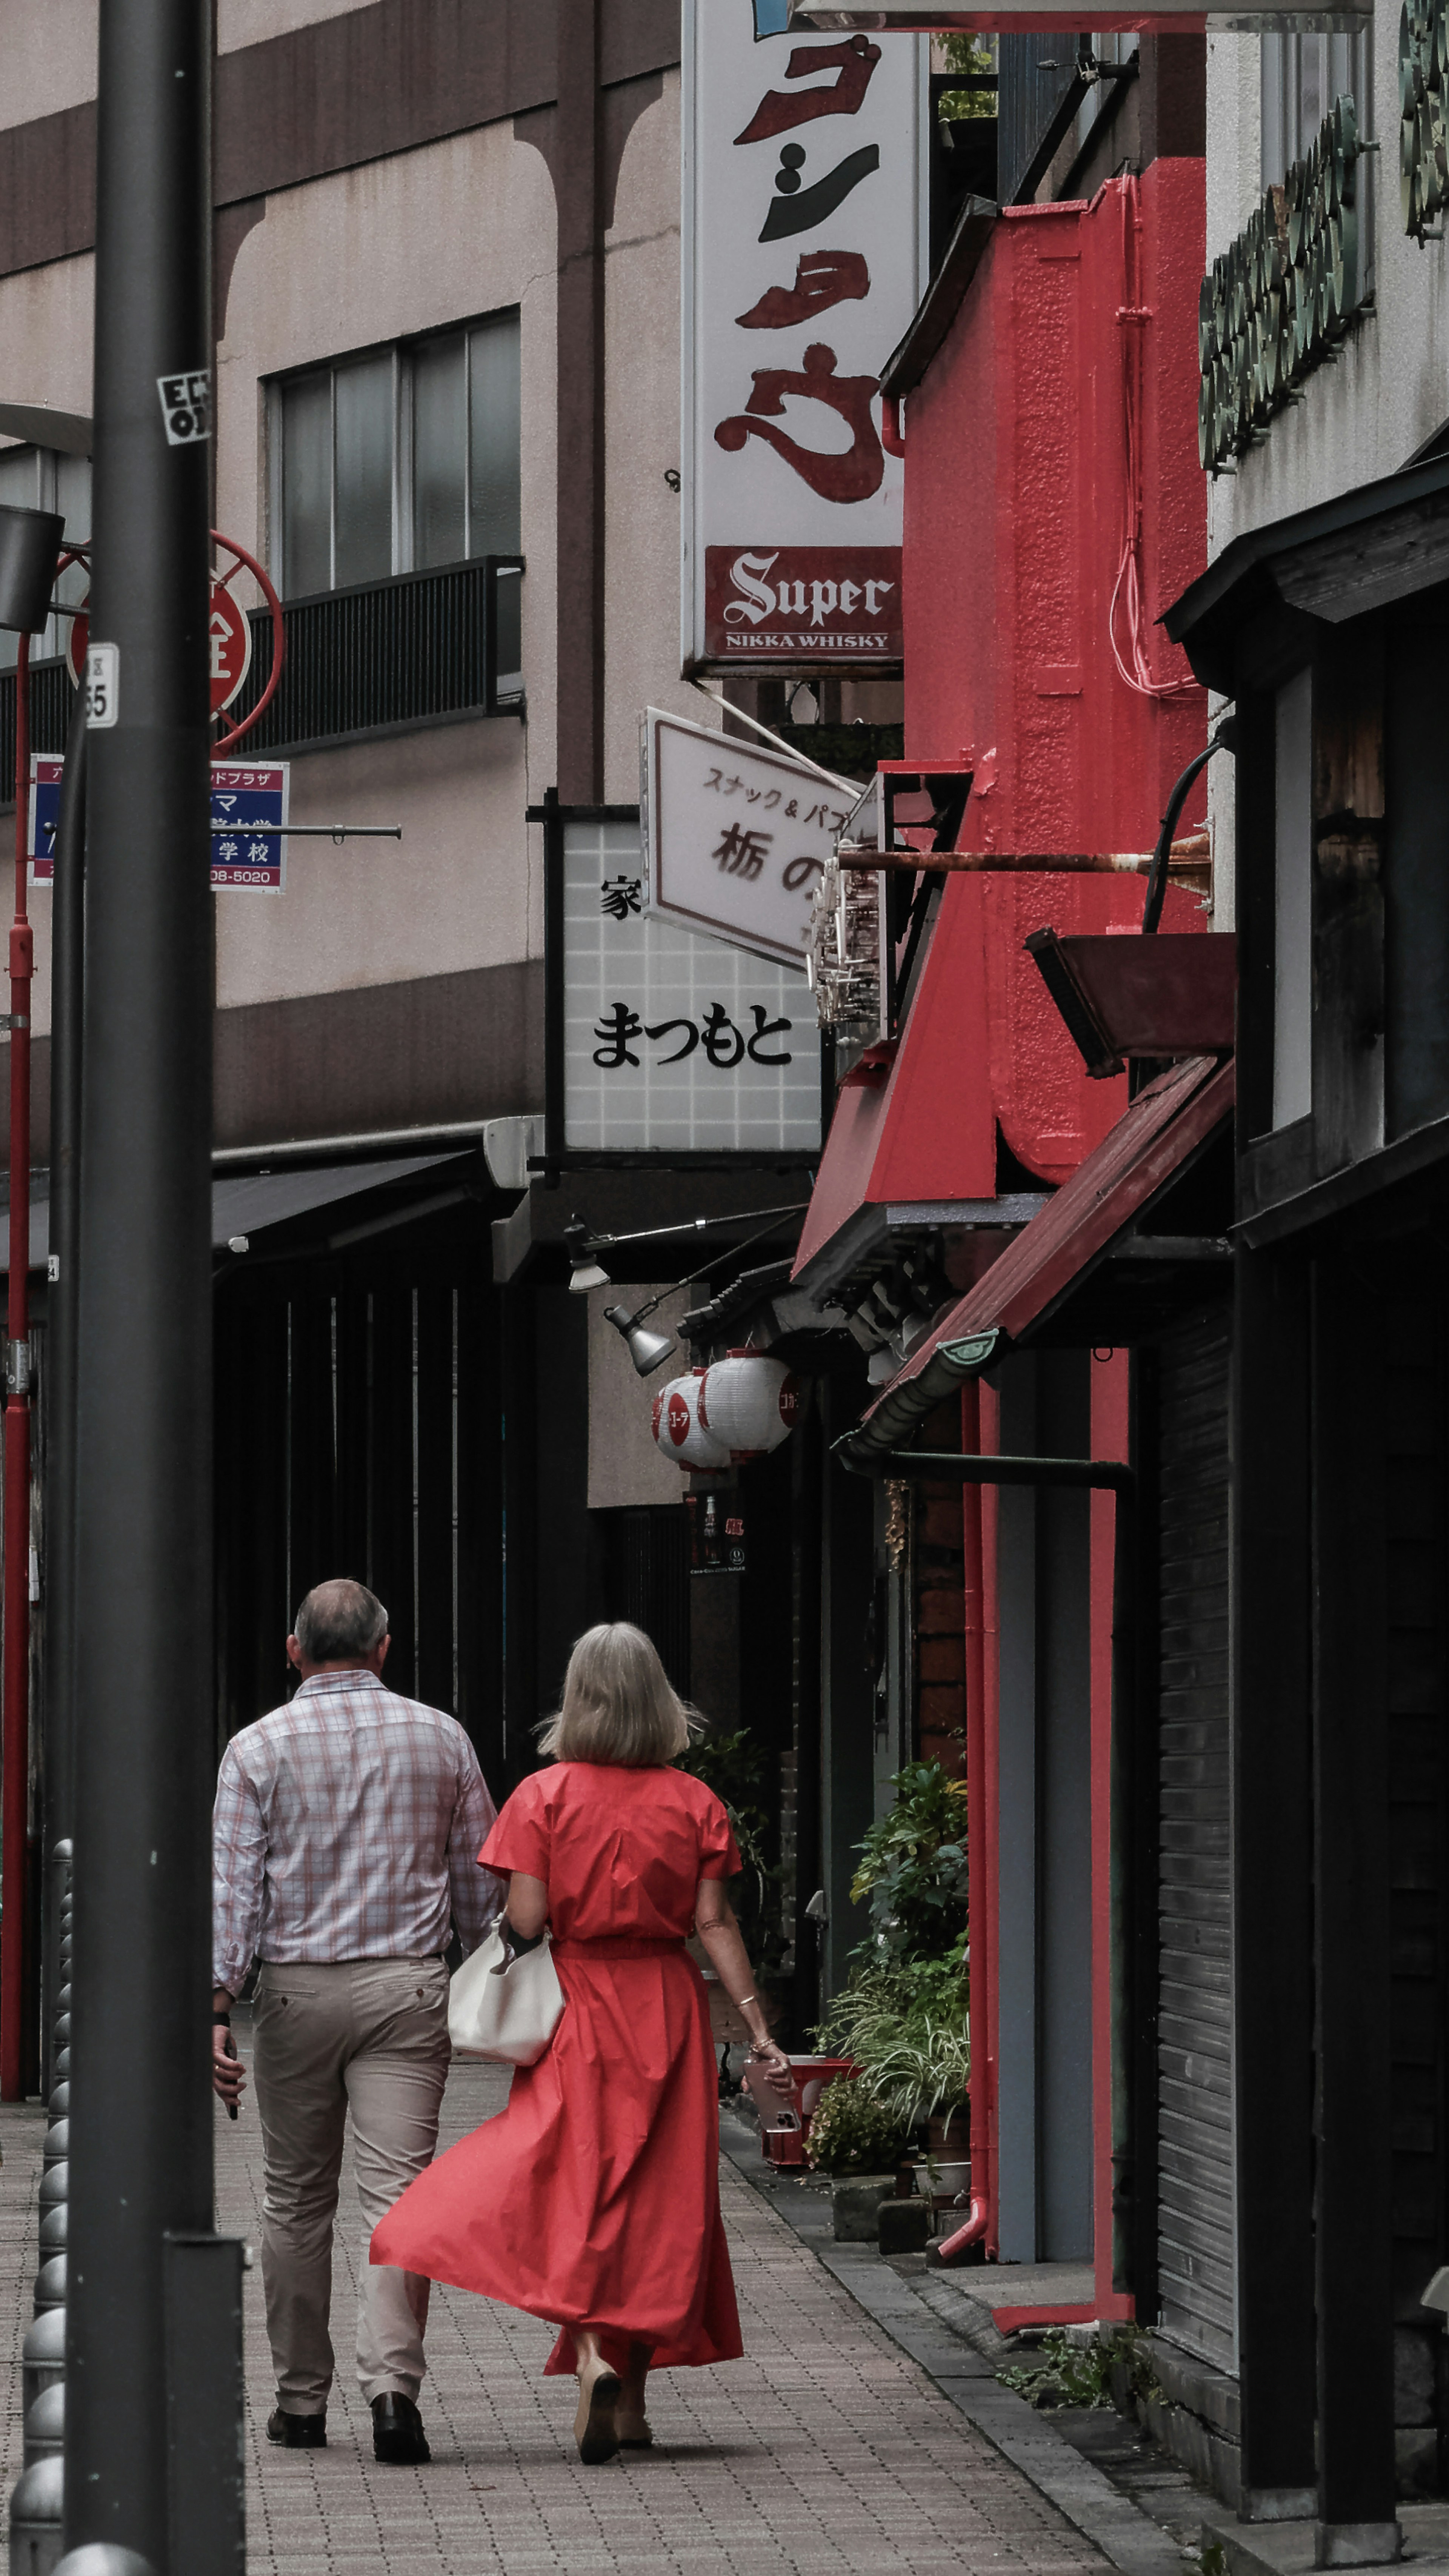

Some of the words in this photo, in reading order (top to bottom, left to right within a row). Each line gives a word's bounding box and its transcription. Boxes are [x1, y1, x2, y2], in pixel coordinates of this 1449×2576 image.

[723, 551, 895, 627] Super
[726, 635, 794, 647] NIKKA
[798, 635, 888, 647] WHISKY
[219, 842, 269, 862] 学校
[593, 1002, 792, 1068] まつもと
